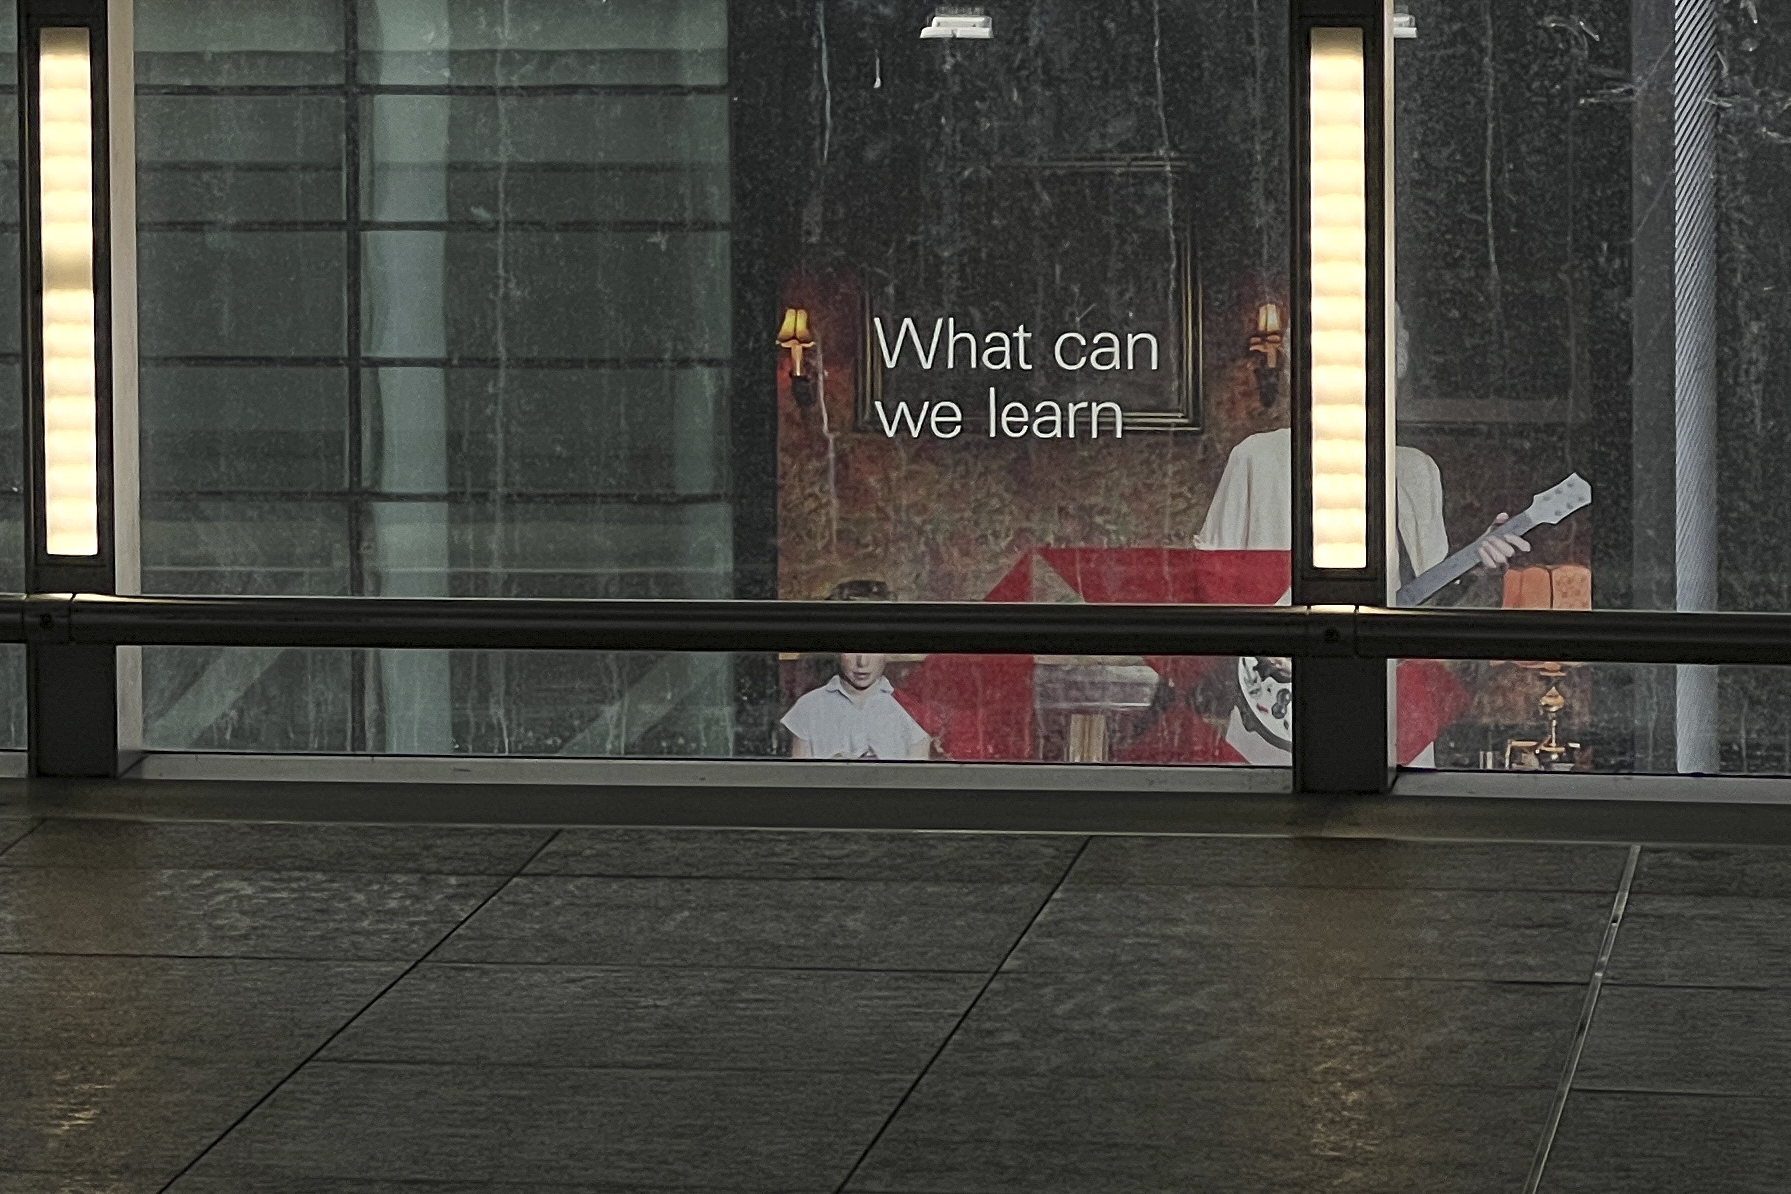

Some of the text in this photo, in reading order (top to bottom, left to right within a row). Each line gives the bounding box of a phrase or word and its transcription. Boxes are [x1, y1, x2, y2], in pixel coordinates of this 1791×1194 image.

[873, 316, 1159, 371] What can
[874, 386, 1123, 439] we learn
